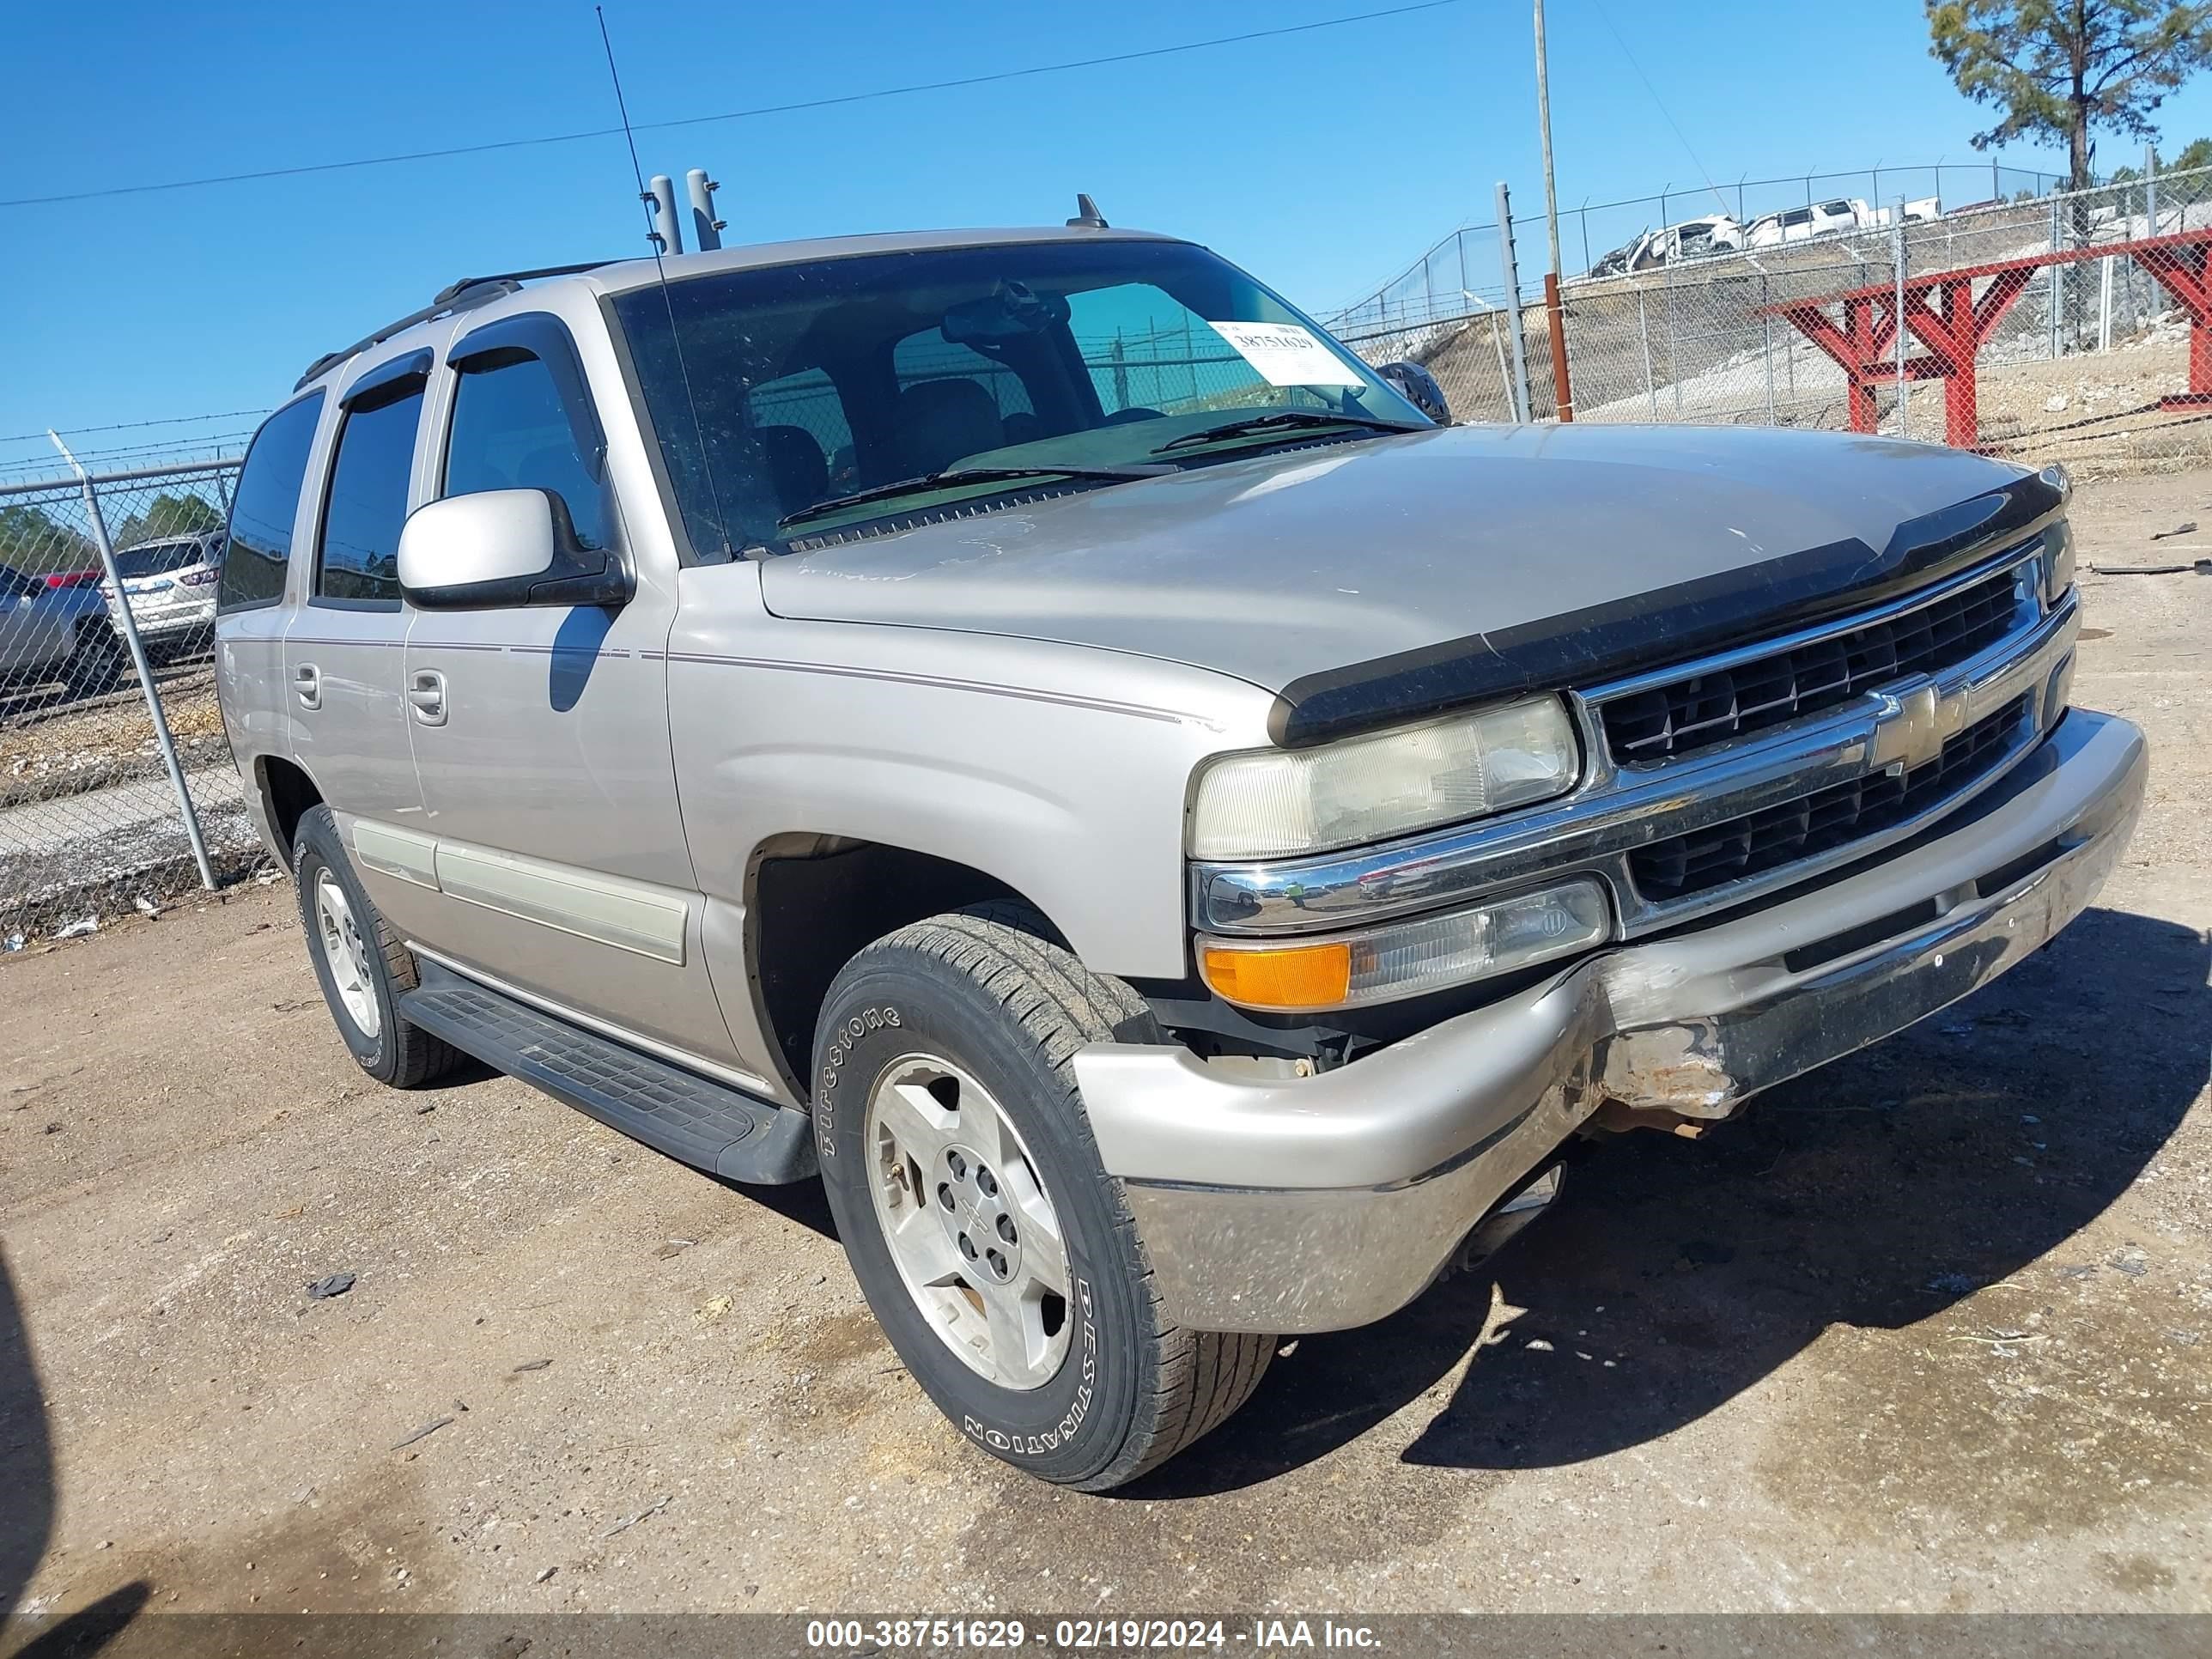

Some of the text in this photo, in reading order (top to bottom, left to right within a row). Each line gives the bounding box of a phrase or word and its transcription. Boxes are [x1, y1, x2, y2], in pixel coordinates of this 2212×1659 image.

[1234, 336, 1313, 349] 38751629
[819, 1006, 902, 1157] Firestone
[964, 1278, 1097, 1455] DESTINATION
